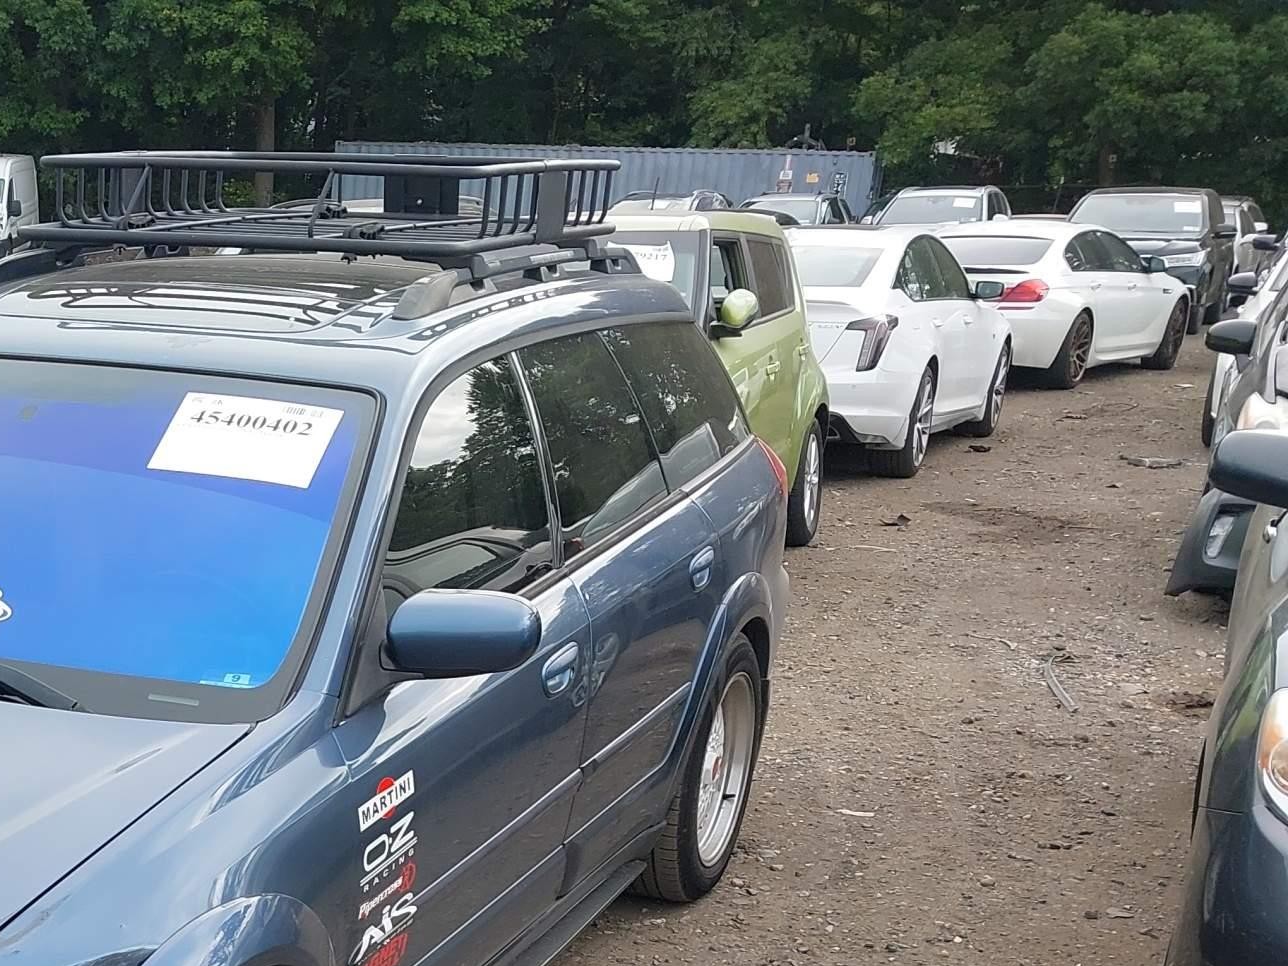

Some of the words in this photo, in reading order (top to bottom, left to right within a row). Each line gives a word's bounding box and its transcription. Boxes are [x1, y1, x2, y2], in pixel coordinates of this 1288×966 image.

[191, 410, 313, 436] 45400402
[361, 776, 411, 825] MARTINI
[363, 849, 414, 893] RACING
